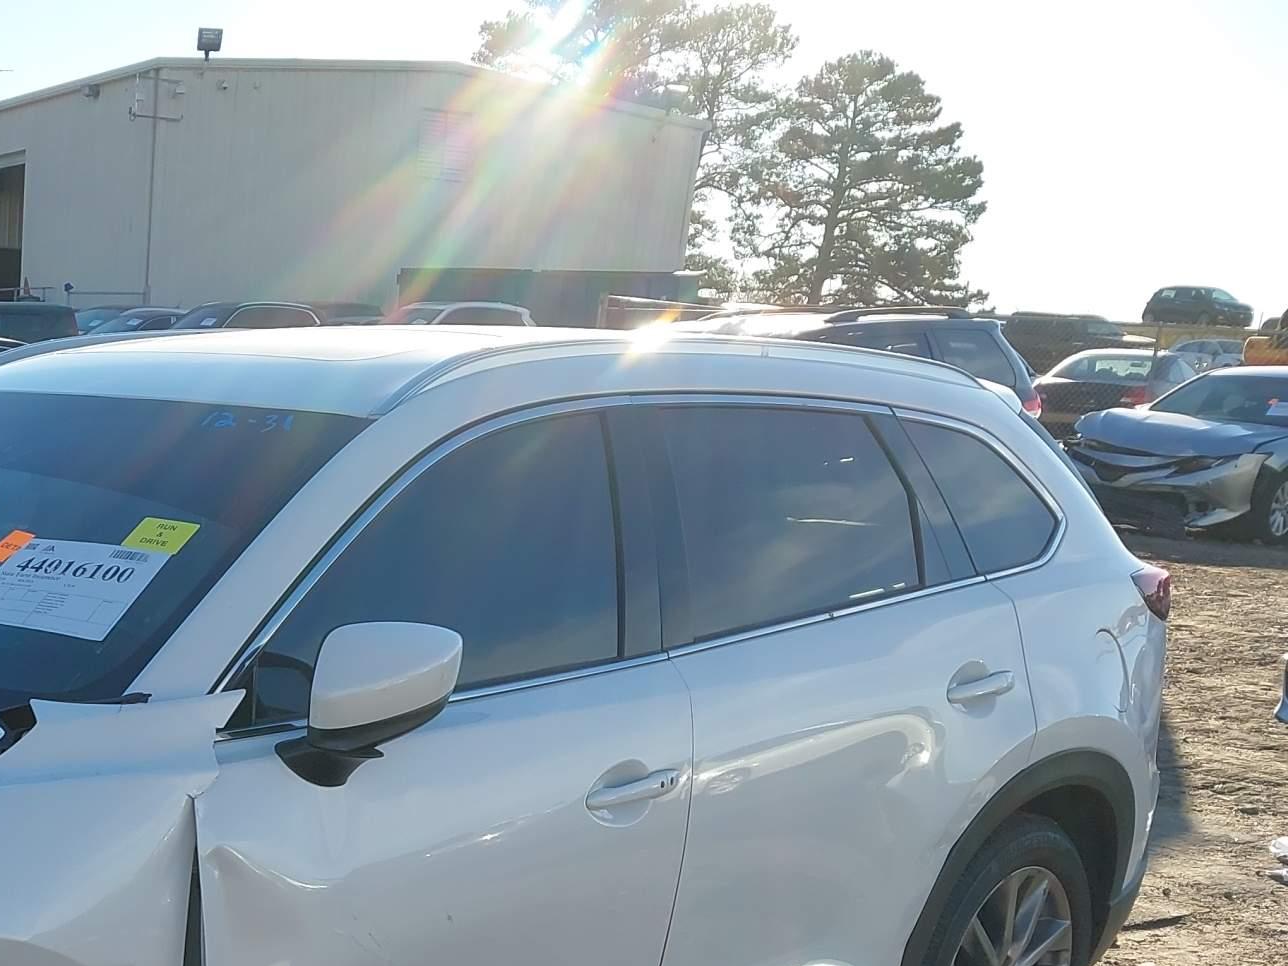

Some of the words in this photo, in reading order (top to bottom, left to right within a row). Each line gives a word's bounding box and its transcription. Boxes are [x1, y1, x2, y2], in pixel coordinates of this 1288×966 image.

[155, 523, 178, 532] RUN
[139, 537, 169, 547] DRIVE
[16, 556, 135, 584] 44016100
